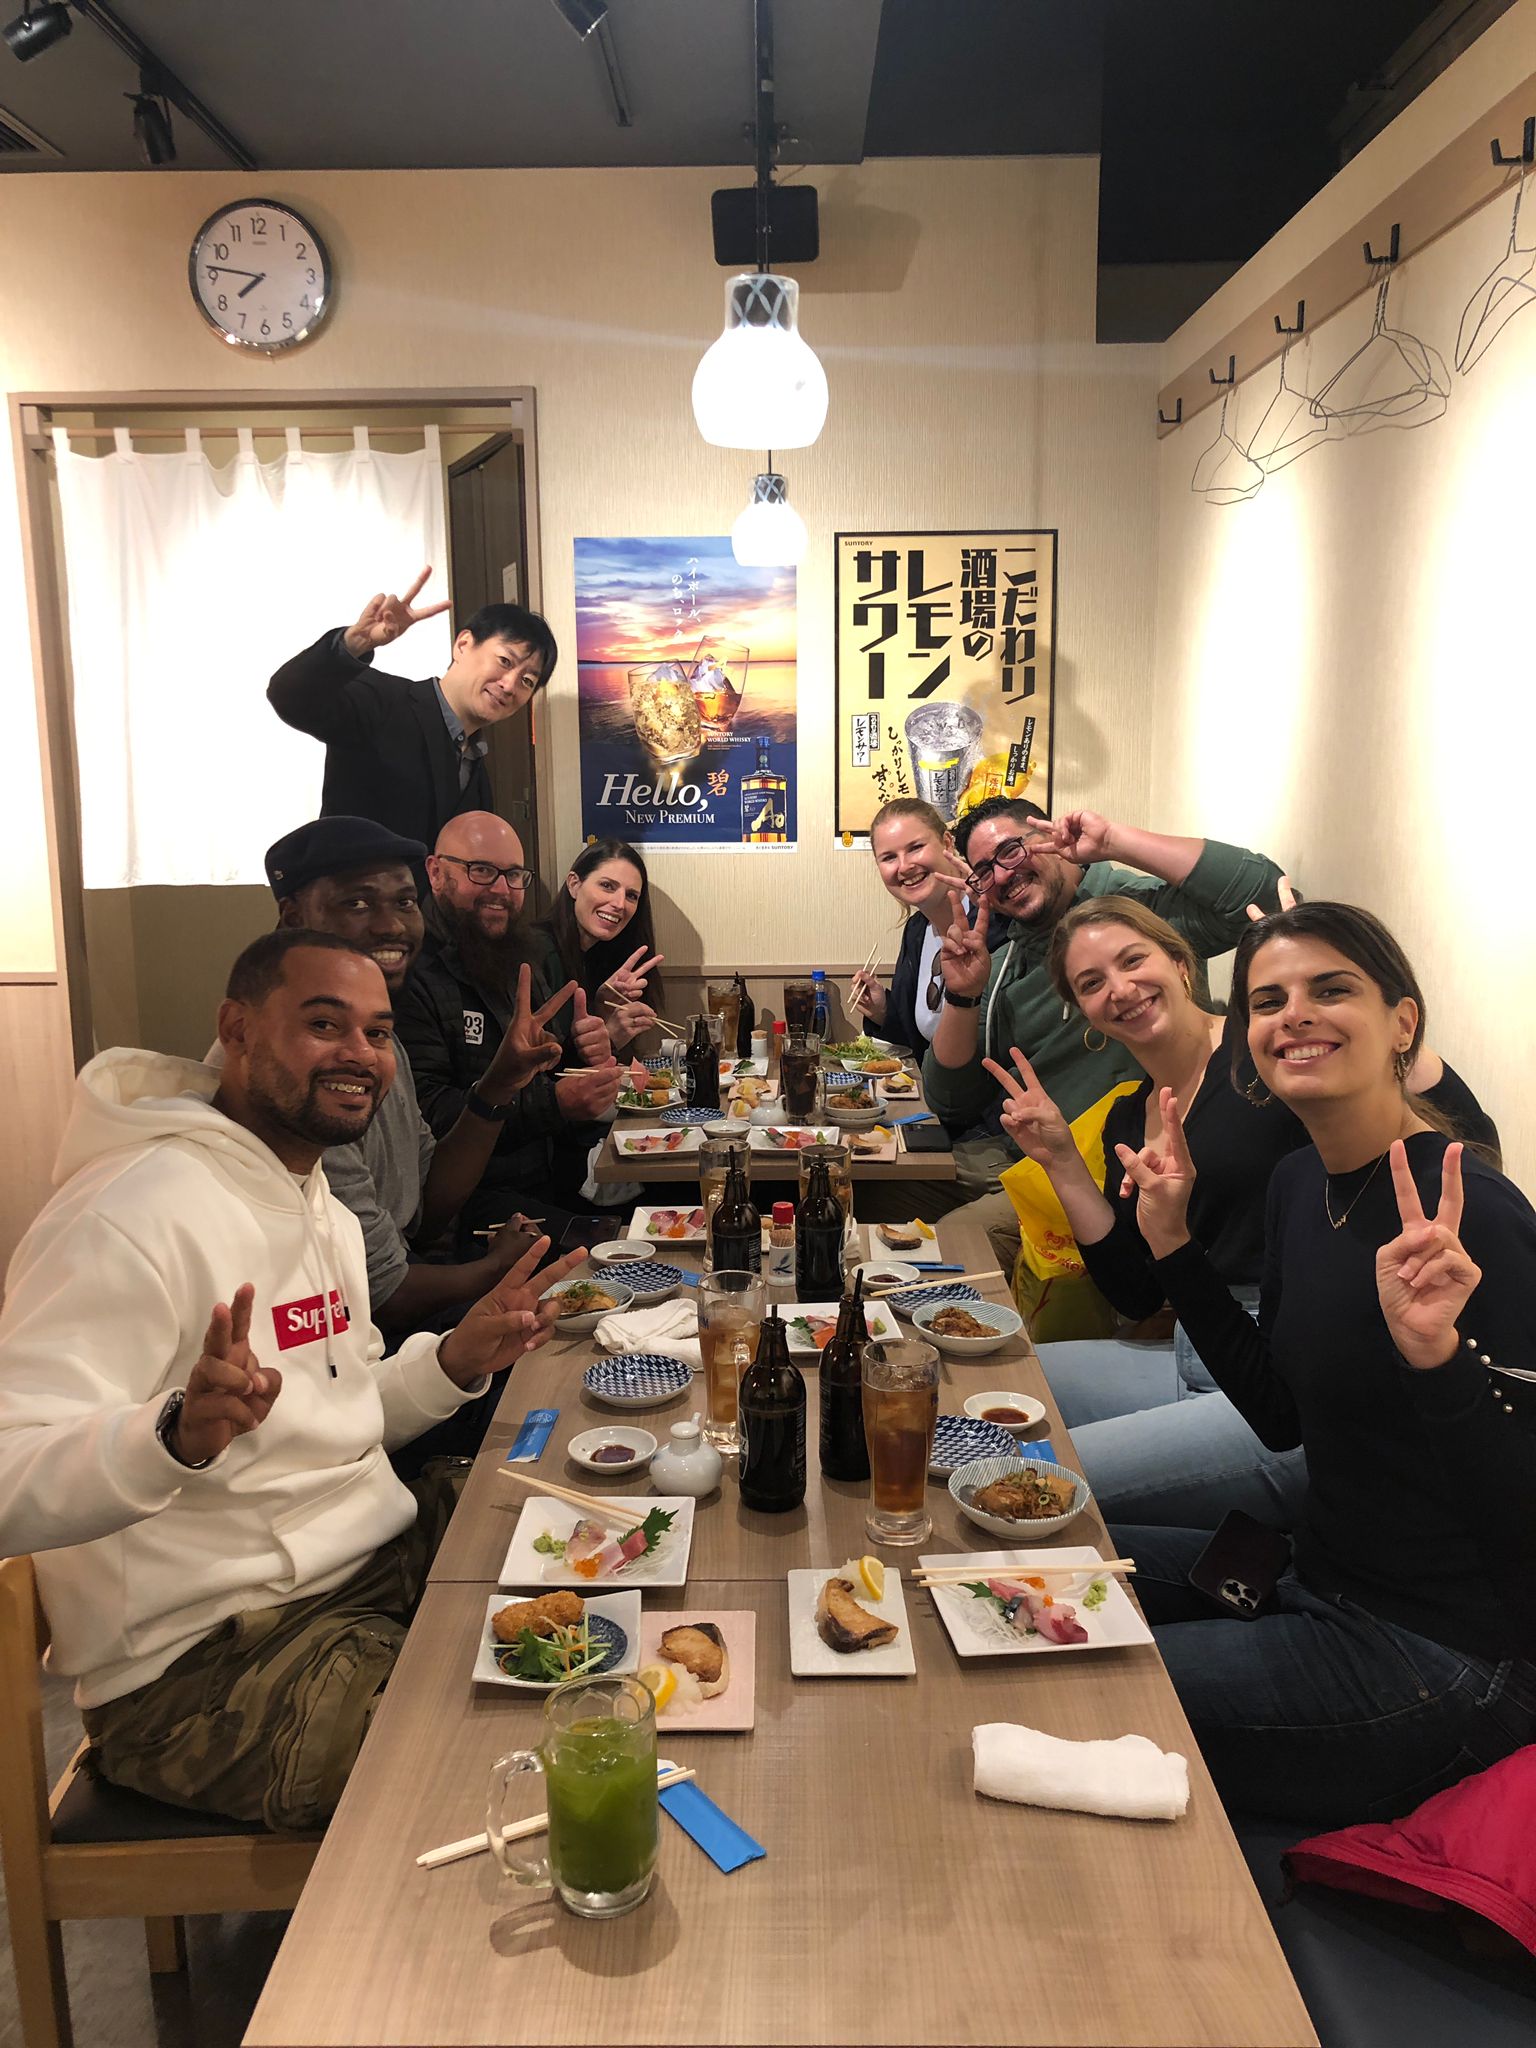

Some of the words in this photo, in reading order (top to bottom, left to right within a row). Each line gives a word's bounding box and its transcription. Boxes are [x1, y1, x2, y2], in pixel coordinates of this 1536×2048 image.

[230, 225, 241, 242] 11
[250, 217, 267, 235] 12
[280, 224, 286, 242] 1
[213, 243, 229, 261] 10
[296, 242, 307, 260] 2
[207, 267, 219, 286] 9
[305, 268, 316, 285] 3
[217, 294, 228, 312] 8
[299, 294, 310, 311] 4
[237, 312, 247, 330] 7
[260, 319, 271, 335] 6
[282, 312, 293, 329] 5
[960, 548, 997, 661] 酒場の
[852, 550, 901, 700] サワー
[906, 550, 953, 699] レモン
[999, 548, 1038, 705] こだわり
[855, 718, 868, 763] レモンサワー
[706, 769, 730, 796] 碧
[596, 772, 709, 812] Hello,
